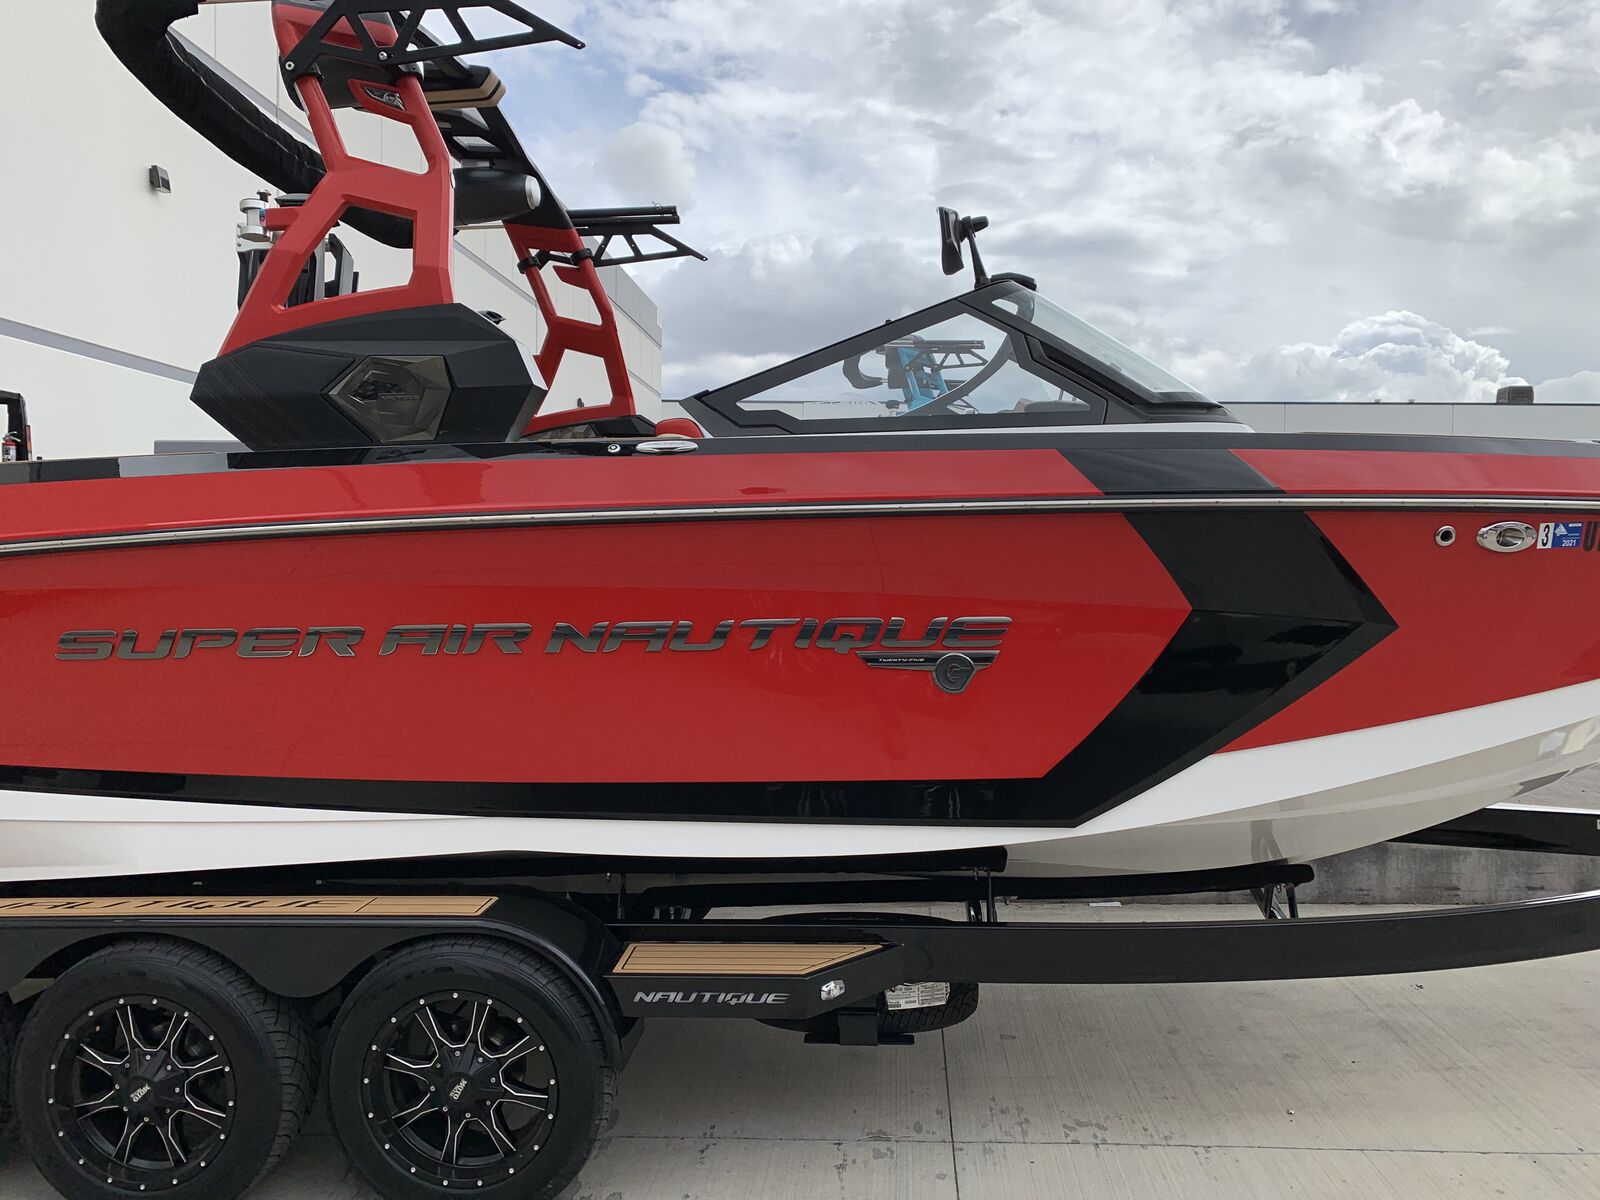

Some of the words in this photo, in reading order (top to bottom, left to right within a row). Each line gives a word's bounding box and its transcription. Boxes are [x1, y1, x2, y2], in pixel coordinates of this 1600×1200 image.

[1541, 524, 1551, 547] 3
[1561, 539, 1577, 547] 2021
[1583, 520, 1600, 552] U
[54, 626, 365, 661] SUPER
[378, 622, 533, 656] AIR
[543, 616, 1013, 654] NAUTIQUE
[632, 991, 792, 1006] NAUTIQUE
